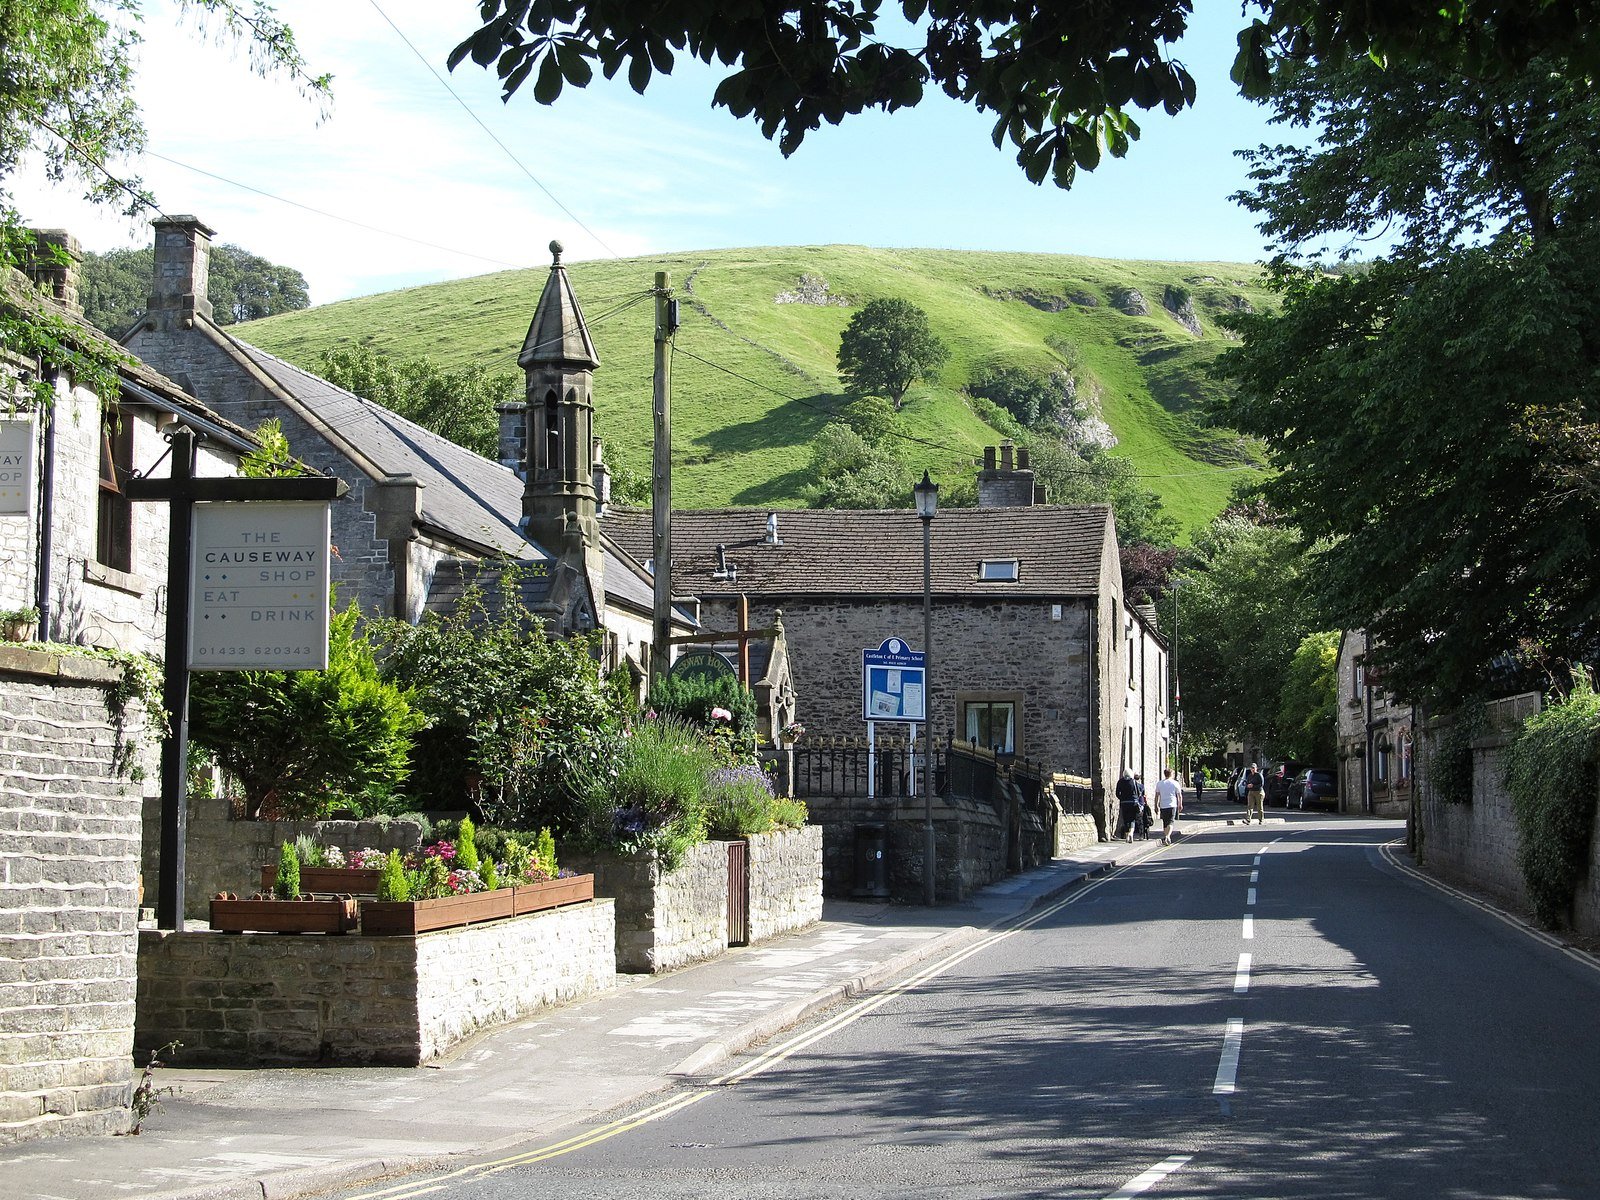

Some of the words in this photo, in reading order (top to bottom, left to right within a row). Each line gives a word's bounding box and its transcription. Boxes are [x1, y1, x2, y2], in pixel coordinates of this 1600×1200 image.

[0, 455, 23, 465] AY
[241, 532, 281, 543] THE
[205, 551, 316, 563] CAUSEWAY
[260, 570, 316, 582] SHOP
[204, 591, 240, 602] EAT
[251, 610, 315, 621] DRINK
[199, 647, 246, 655] 01433
[254, 646, 311, 655] 620343
